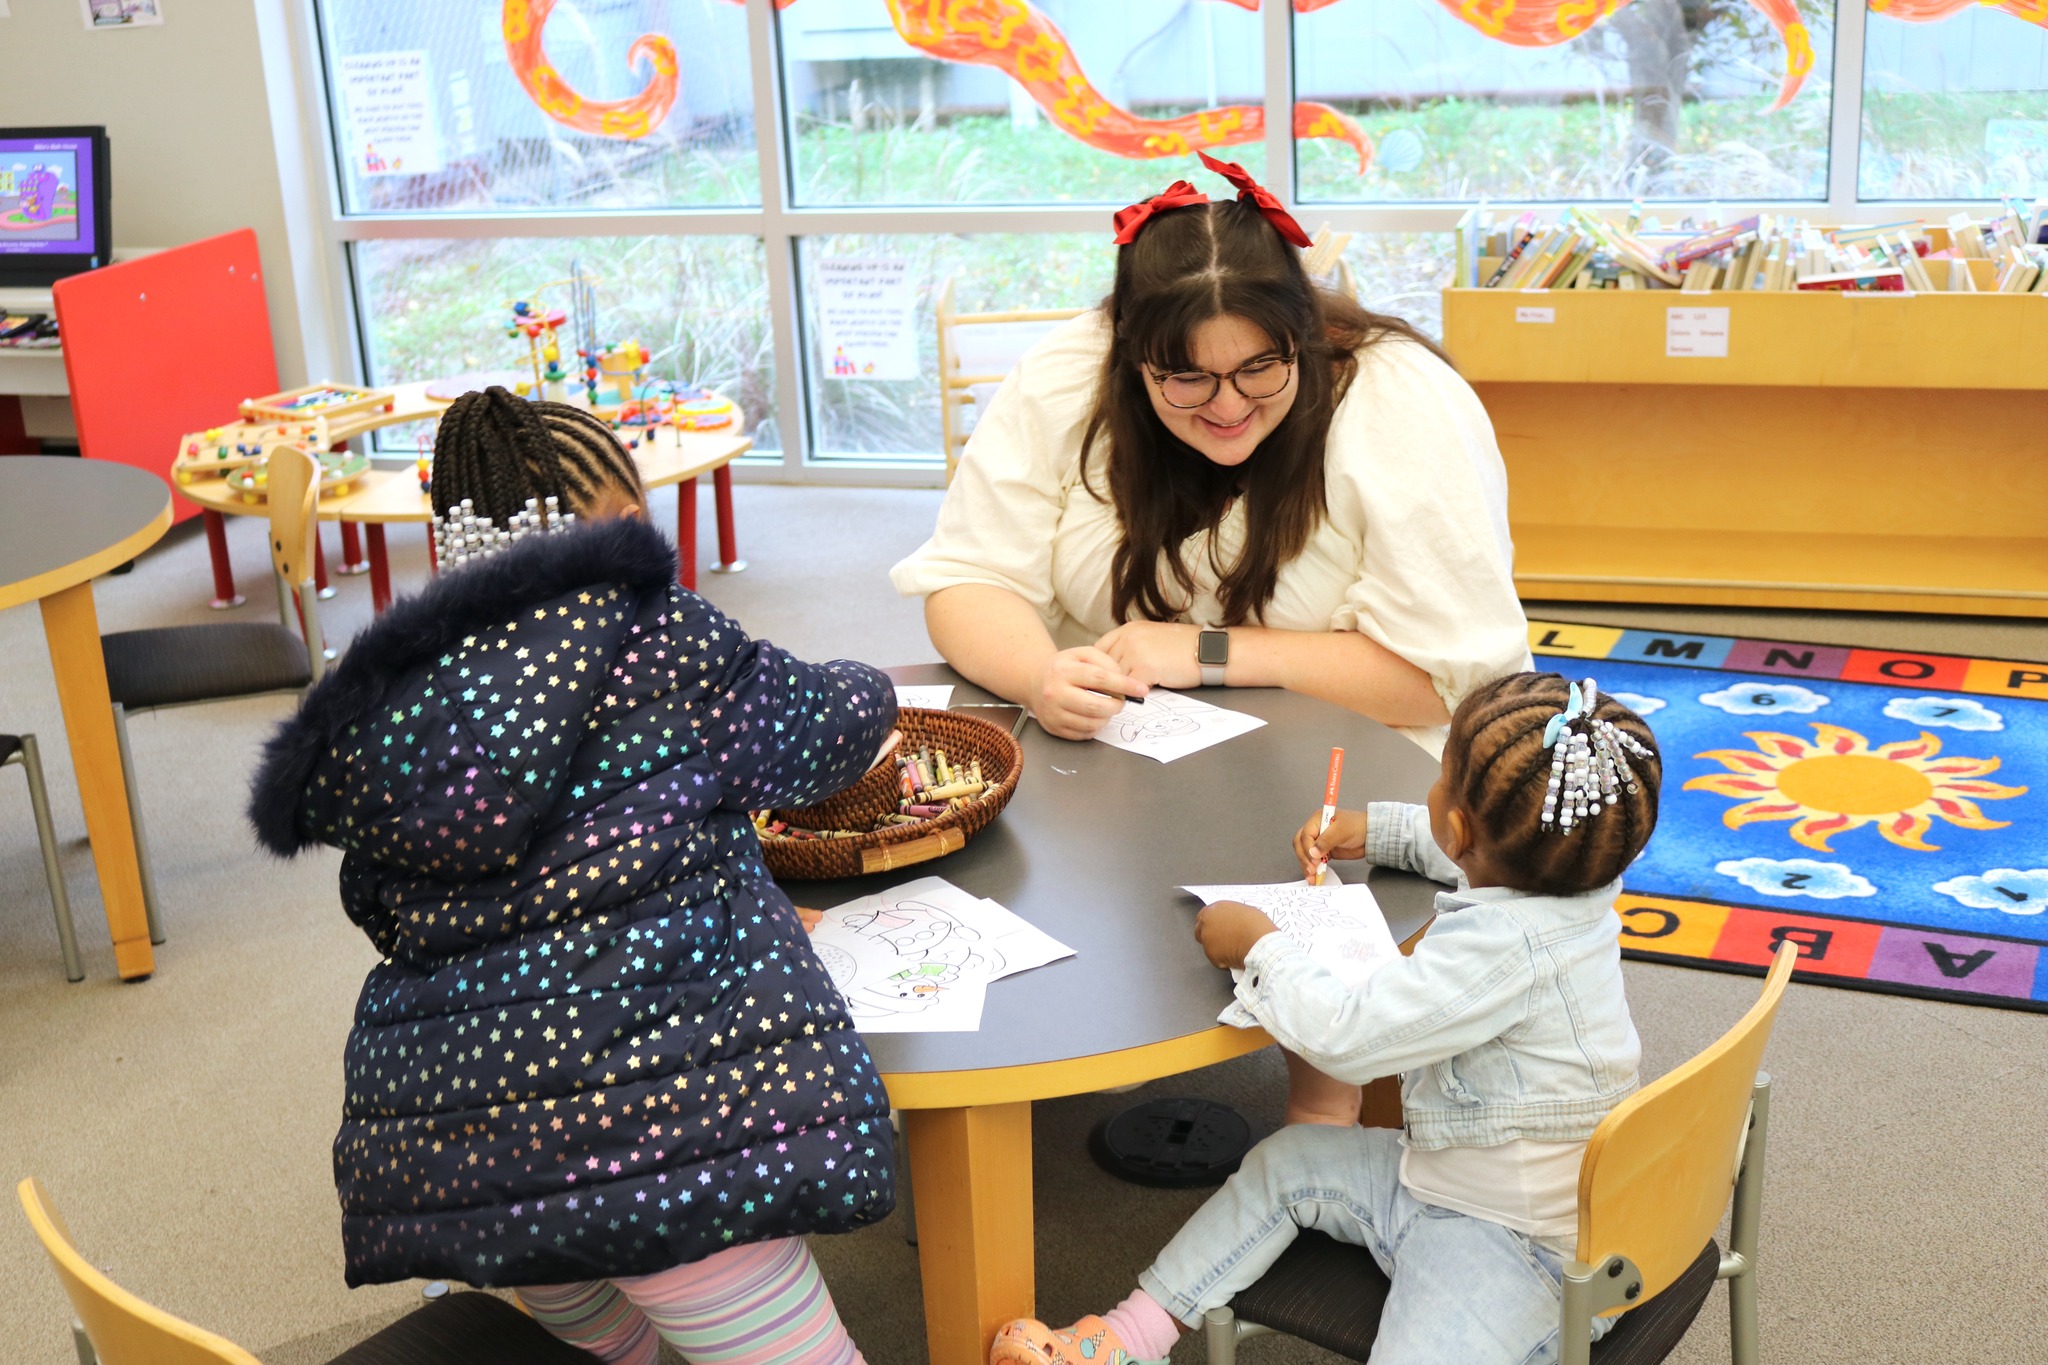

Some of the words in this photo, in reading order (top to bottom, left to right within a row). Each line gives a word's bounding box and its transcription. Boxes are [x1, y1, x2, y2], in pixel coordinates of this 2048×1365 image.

[1538, 630, 1576, 649] L
[1643, 638, 1706, 660] M
[1763, 648, 1816, 670] N
[1878, 660, 1936, 679] O
[2007, 670, 2048, 688] P
[1751, 693, 1776, 707] 6
[1931, 707, 1960, 718] 7
[1781, 873, 1812, 890] 2
[1994, 886, 2029, 902] 1
[1621, 907, 1680, 938] C
[1768, 926, 1833, 960] B
[1921, 941, 1998, 979] A
